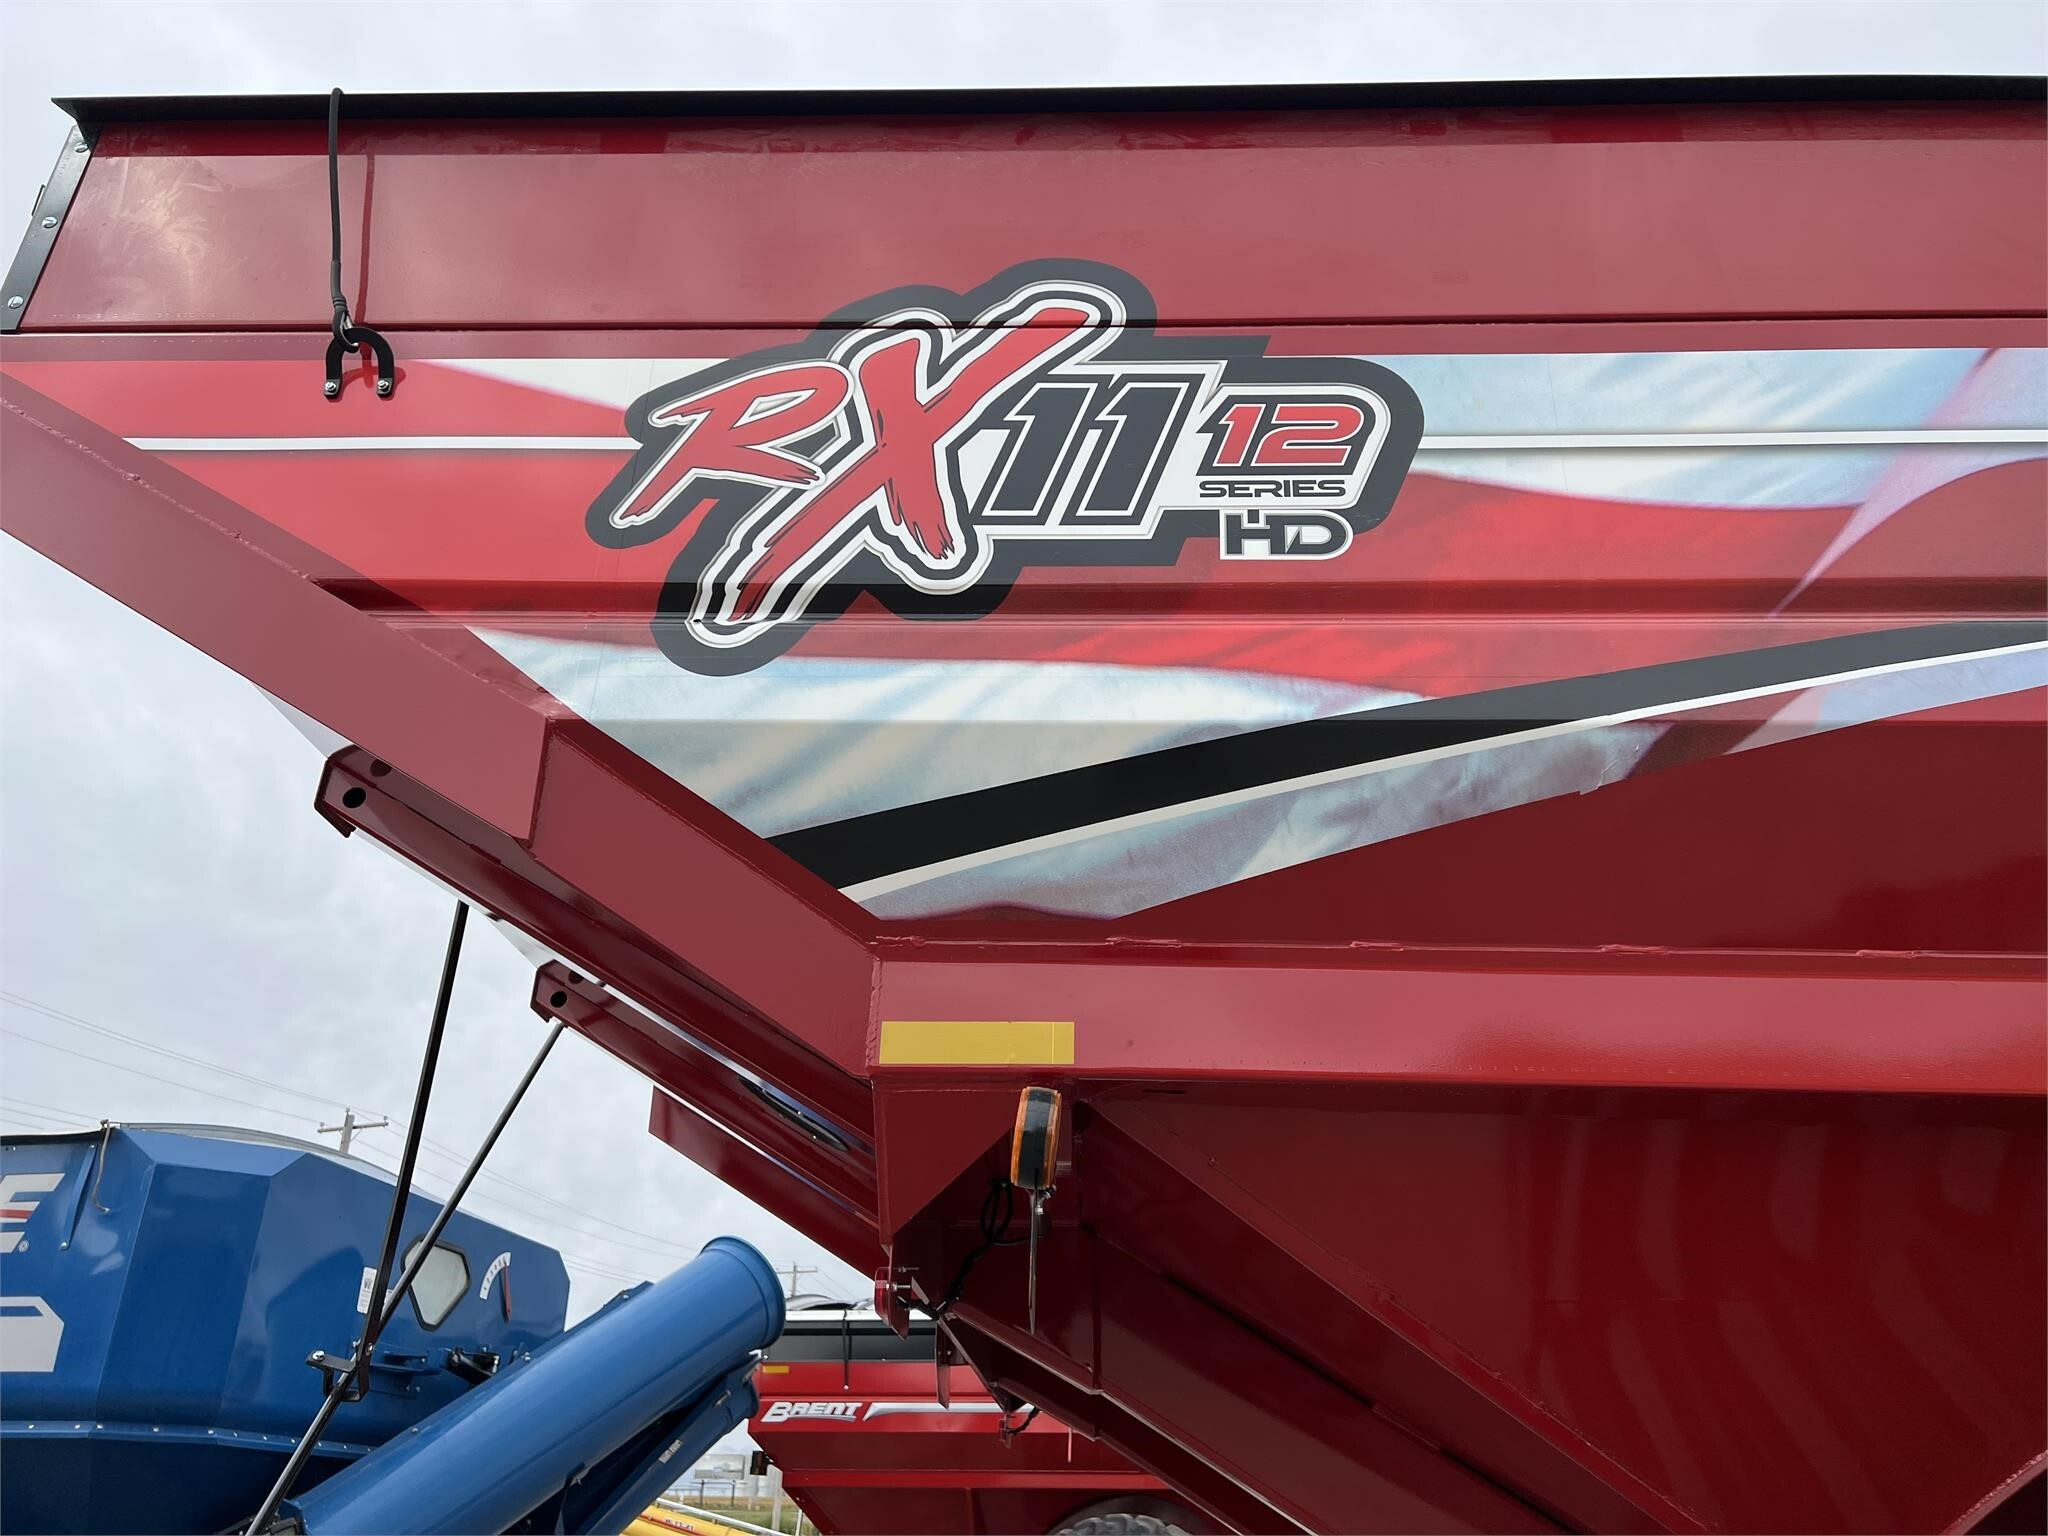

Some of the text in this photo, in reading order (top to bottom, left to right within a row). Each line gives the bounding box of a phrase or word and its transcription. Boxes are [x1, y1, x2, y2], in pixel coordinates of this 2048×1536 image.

[1212, 402, 1365, 467] 12
[1198, 478, 1347, 498] SERIES
[1223, 508, 1349, 558] HD
[760, 1401, 863, 1423] BRENT
